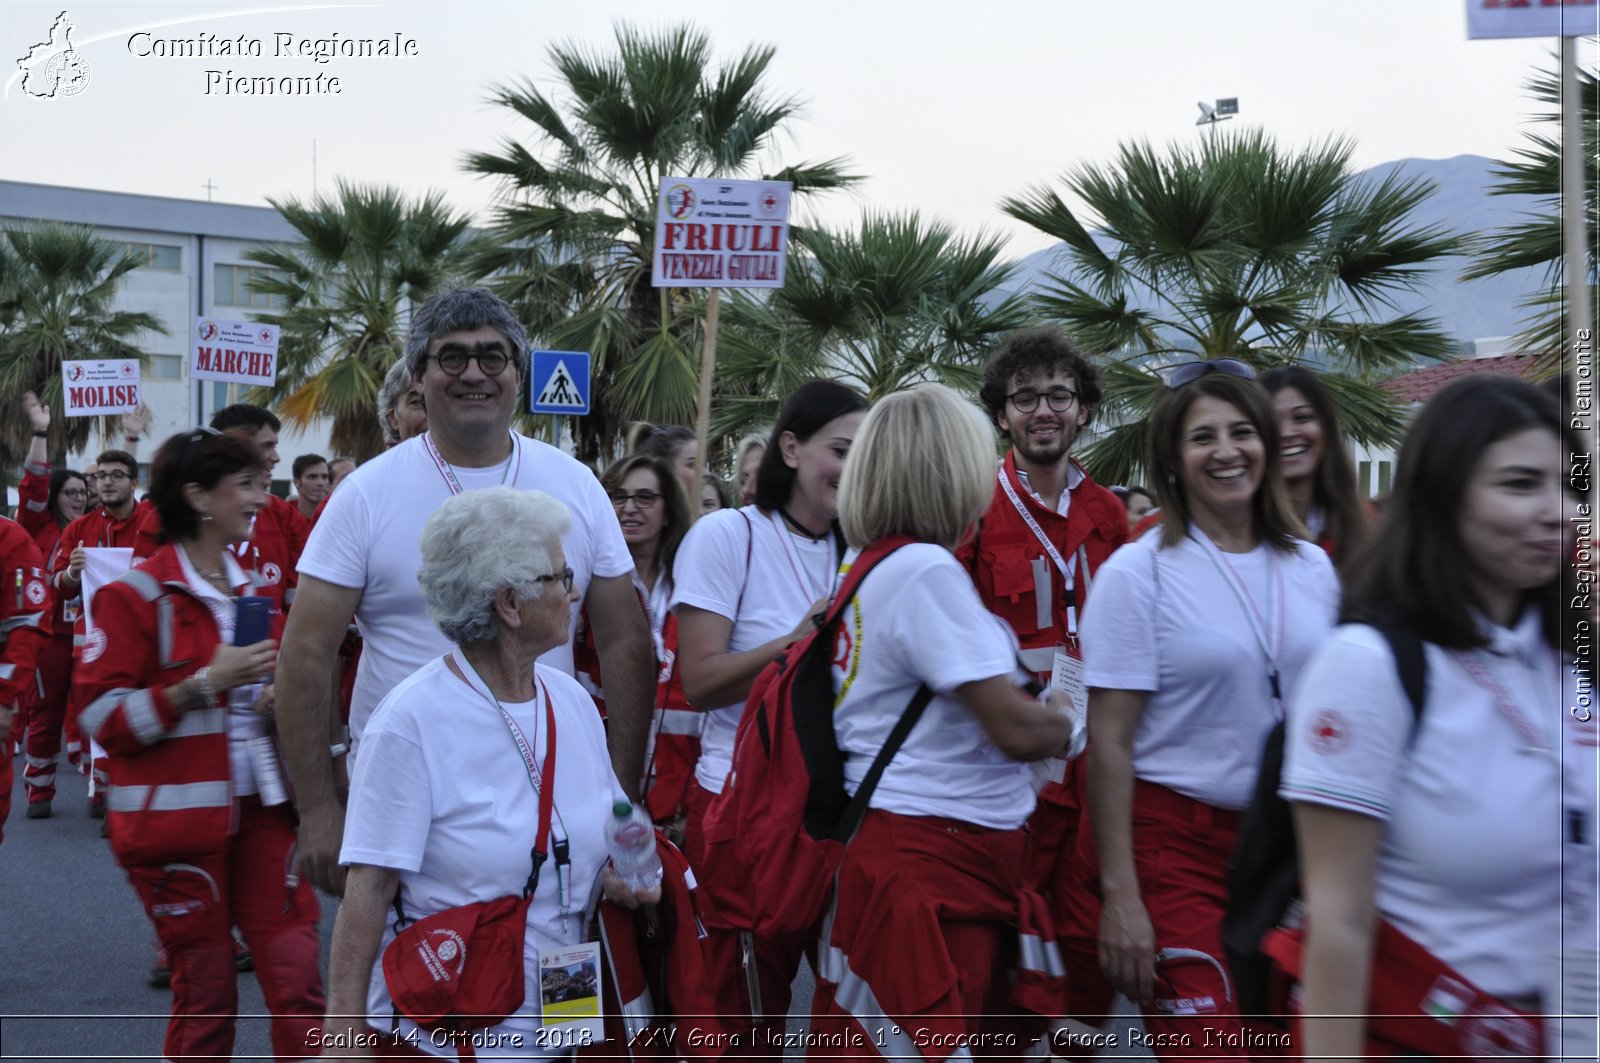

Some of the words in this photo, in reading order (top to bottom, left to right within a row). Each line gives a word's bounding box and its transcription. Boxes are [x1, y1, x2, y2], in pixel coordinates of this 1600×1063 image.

[662, 222, 783, 252] FRIULI
[661, 253, 723, 280] VENEZIA
[727, 254, 778, 280] GIULIA
[196, 346, 273, 377] MARCHE
[69, 384, 138, 408] MOLISE
[517, 738, 537, 775] OTTOBRE
